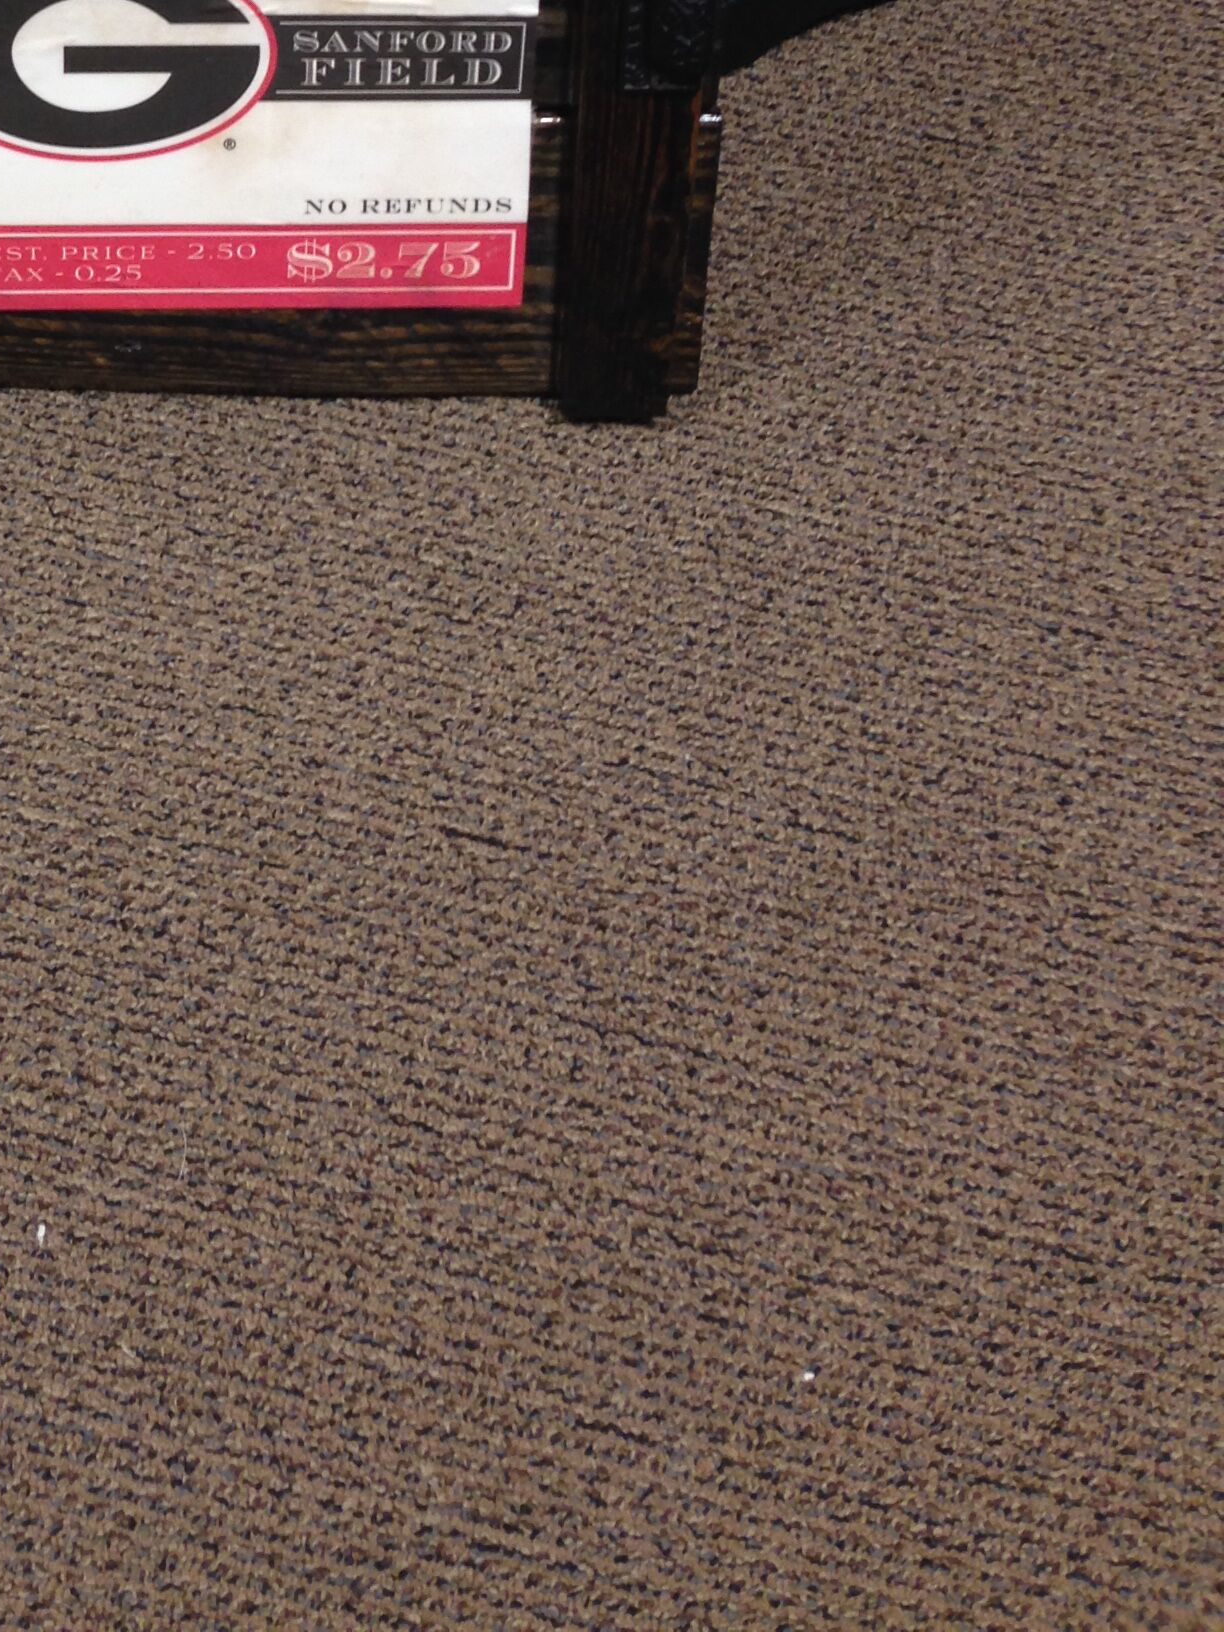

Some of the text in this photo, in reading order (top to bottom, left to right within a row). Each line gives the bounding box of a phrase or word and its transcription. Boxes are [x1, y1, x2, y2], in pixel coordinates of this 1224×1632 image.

[292, 29, 513, 54] SANFORD
[300, 57, 504, 87] FIELD
[304, 198, 513, 215] NO REFUNDS
[61, 245, 156, 261] PRICE
[187, 243, 257, 261] 2.50
[286, 238, 482, 284] $2.75
[74, 265, 143, 283] 0.25
